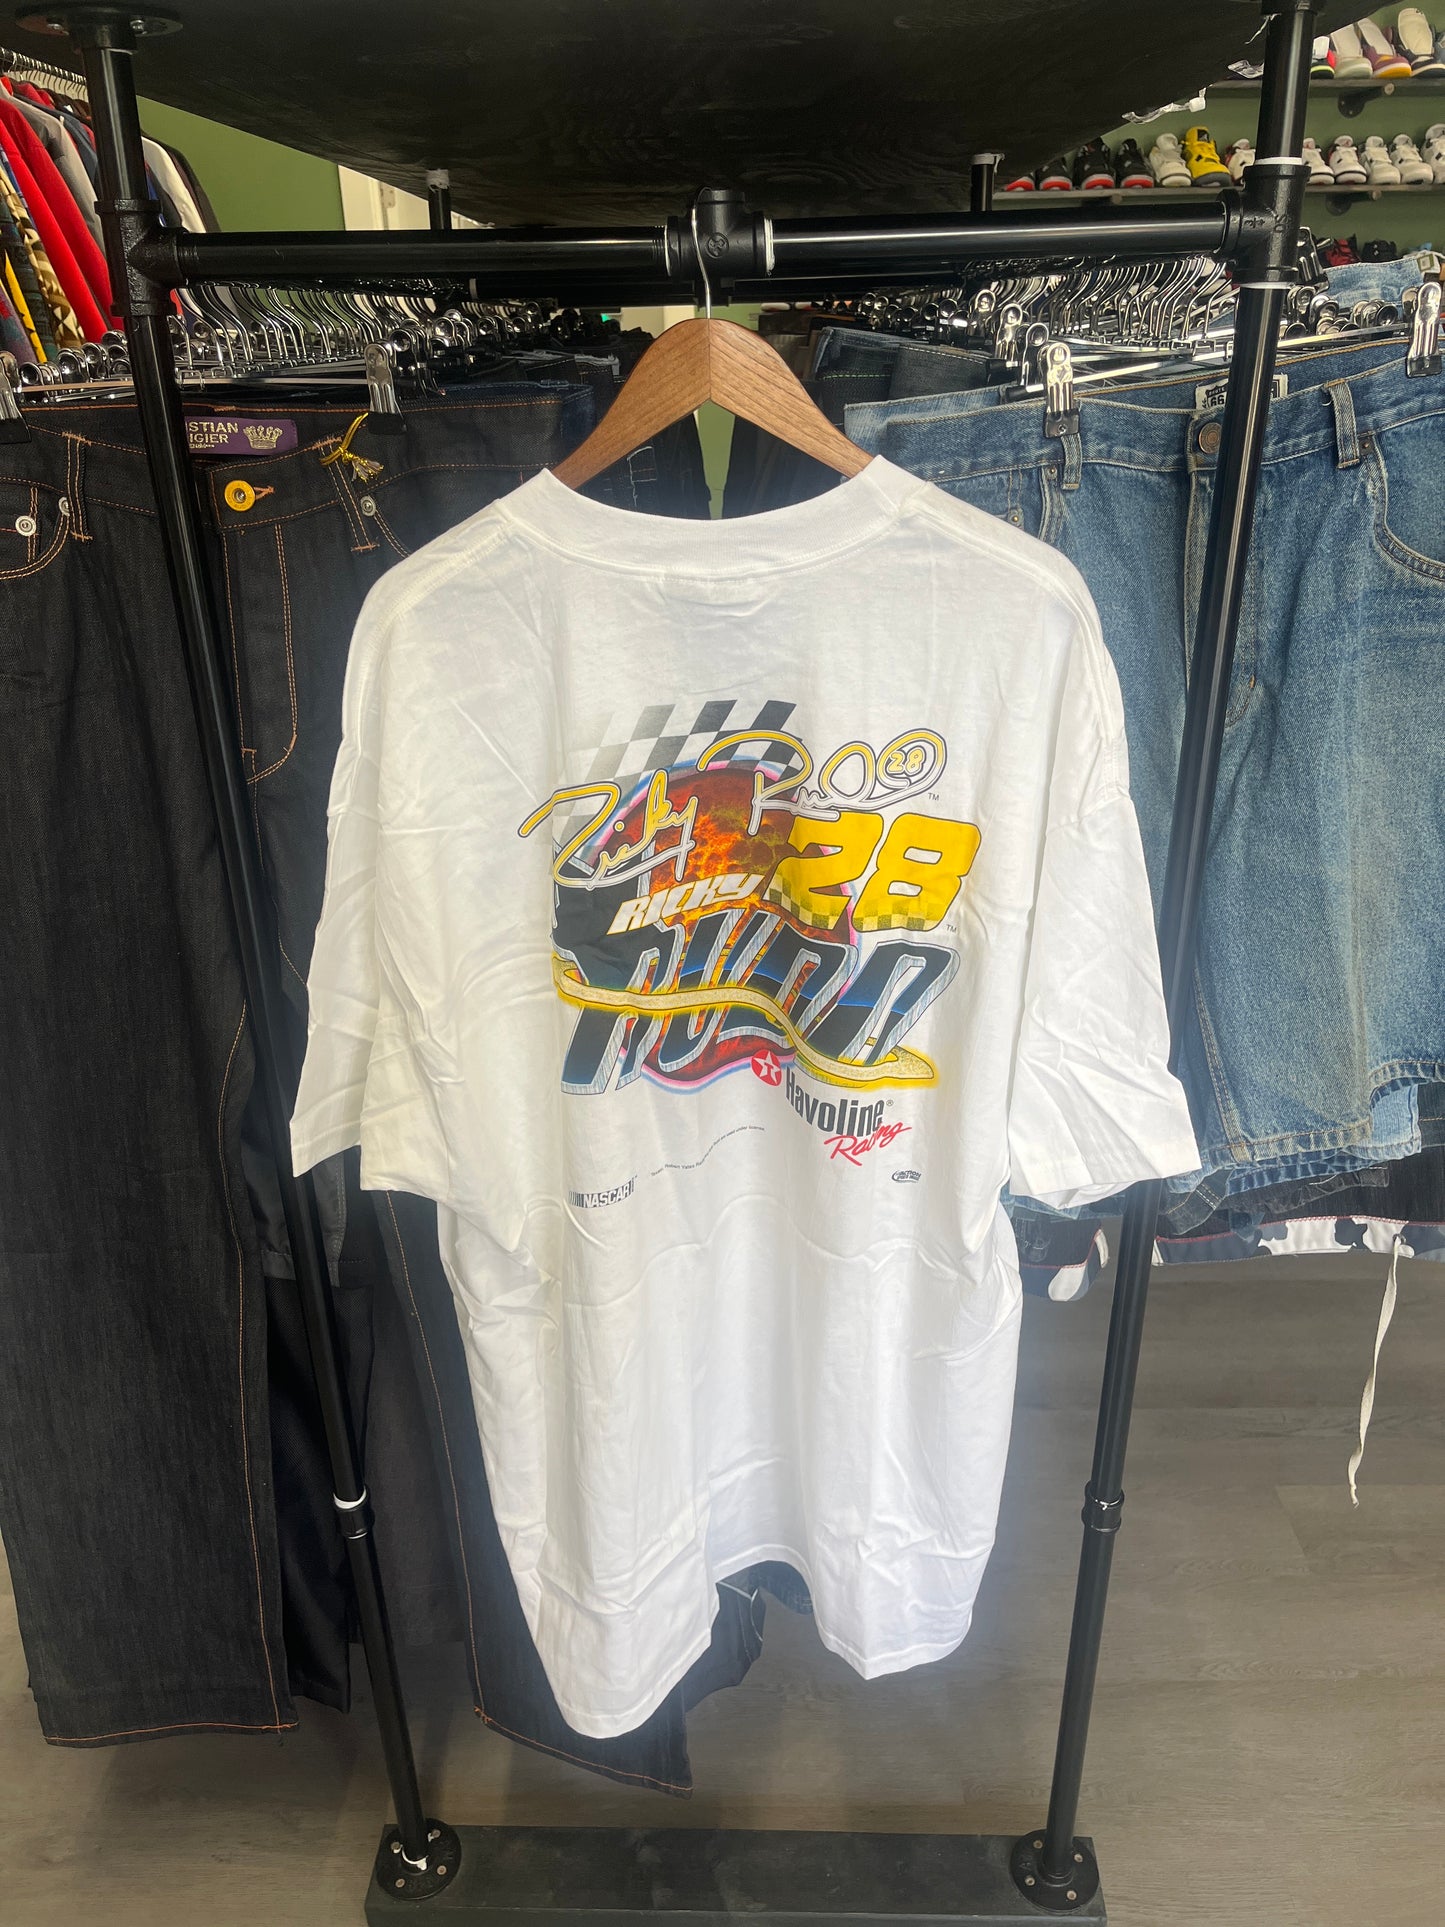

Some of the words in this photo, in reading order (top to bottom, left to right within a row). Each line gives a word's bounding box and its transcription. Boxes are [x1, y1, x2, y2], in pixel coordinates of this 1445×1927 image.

[1210, 395, 1225, 407] 66
[189, 433, 230, 444] IGIER
[886, 745, 927, 777] 28
[763, 811, 982, 934] 28
[606, 873, 765, 936] RICKY
[785, 1066, 886, 1138] Havoline
[583, 1183, 631, 1208] NASCAR
